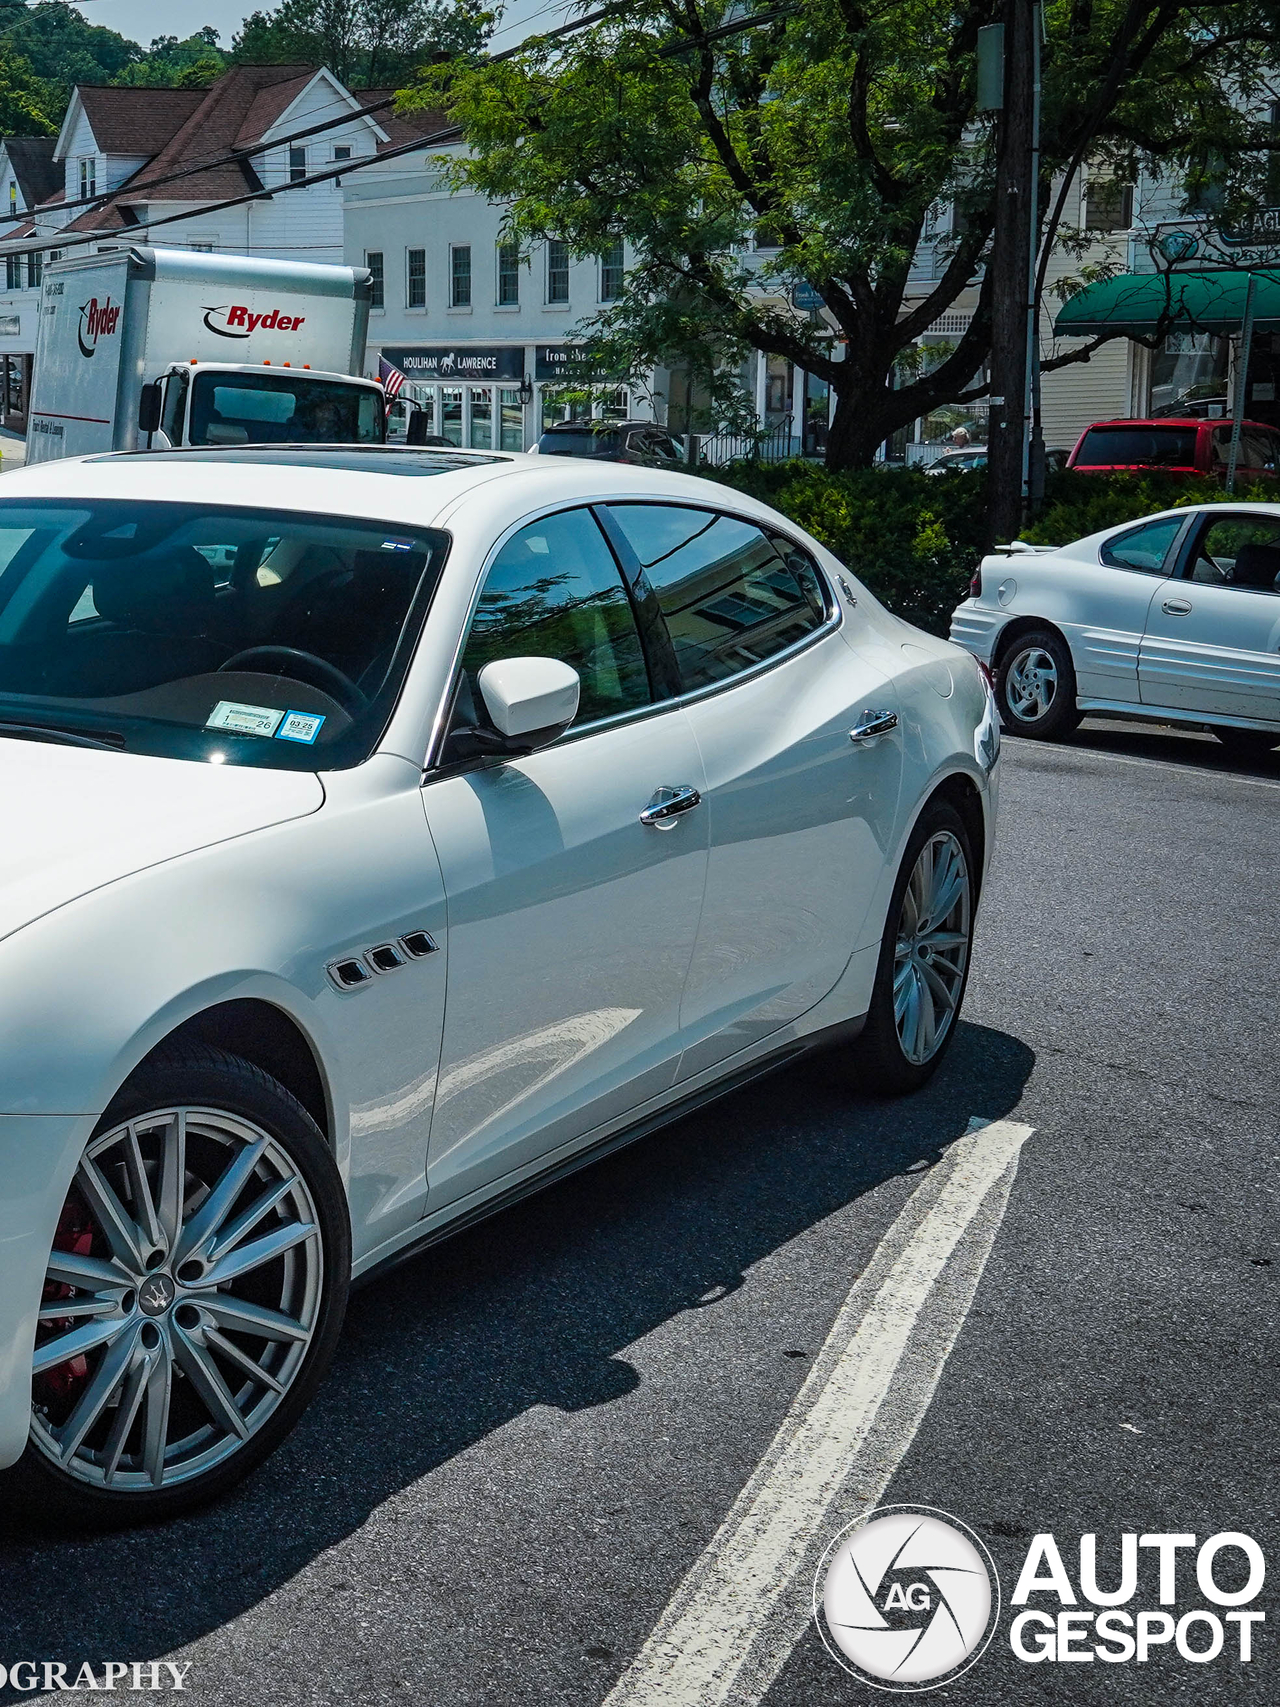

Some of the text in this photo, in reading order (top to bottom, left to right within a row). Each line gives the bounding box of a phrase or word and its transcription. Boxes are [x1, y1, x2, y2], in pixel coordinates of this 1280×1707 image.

[87, 296, 120, 344] Ryder
[226, 305, 306, 332] Ryder
[545, 348, 567, 362] from
[403, 356, 497, 369] HOULIHAN LAWRENCE
[255, 720, 271, 730] 26
